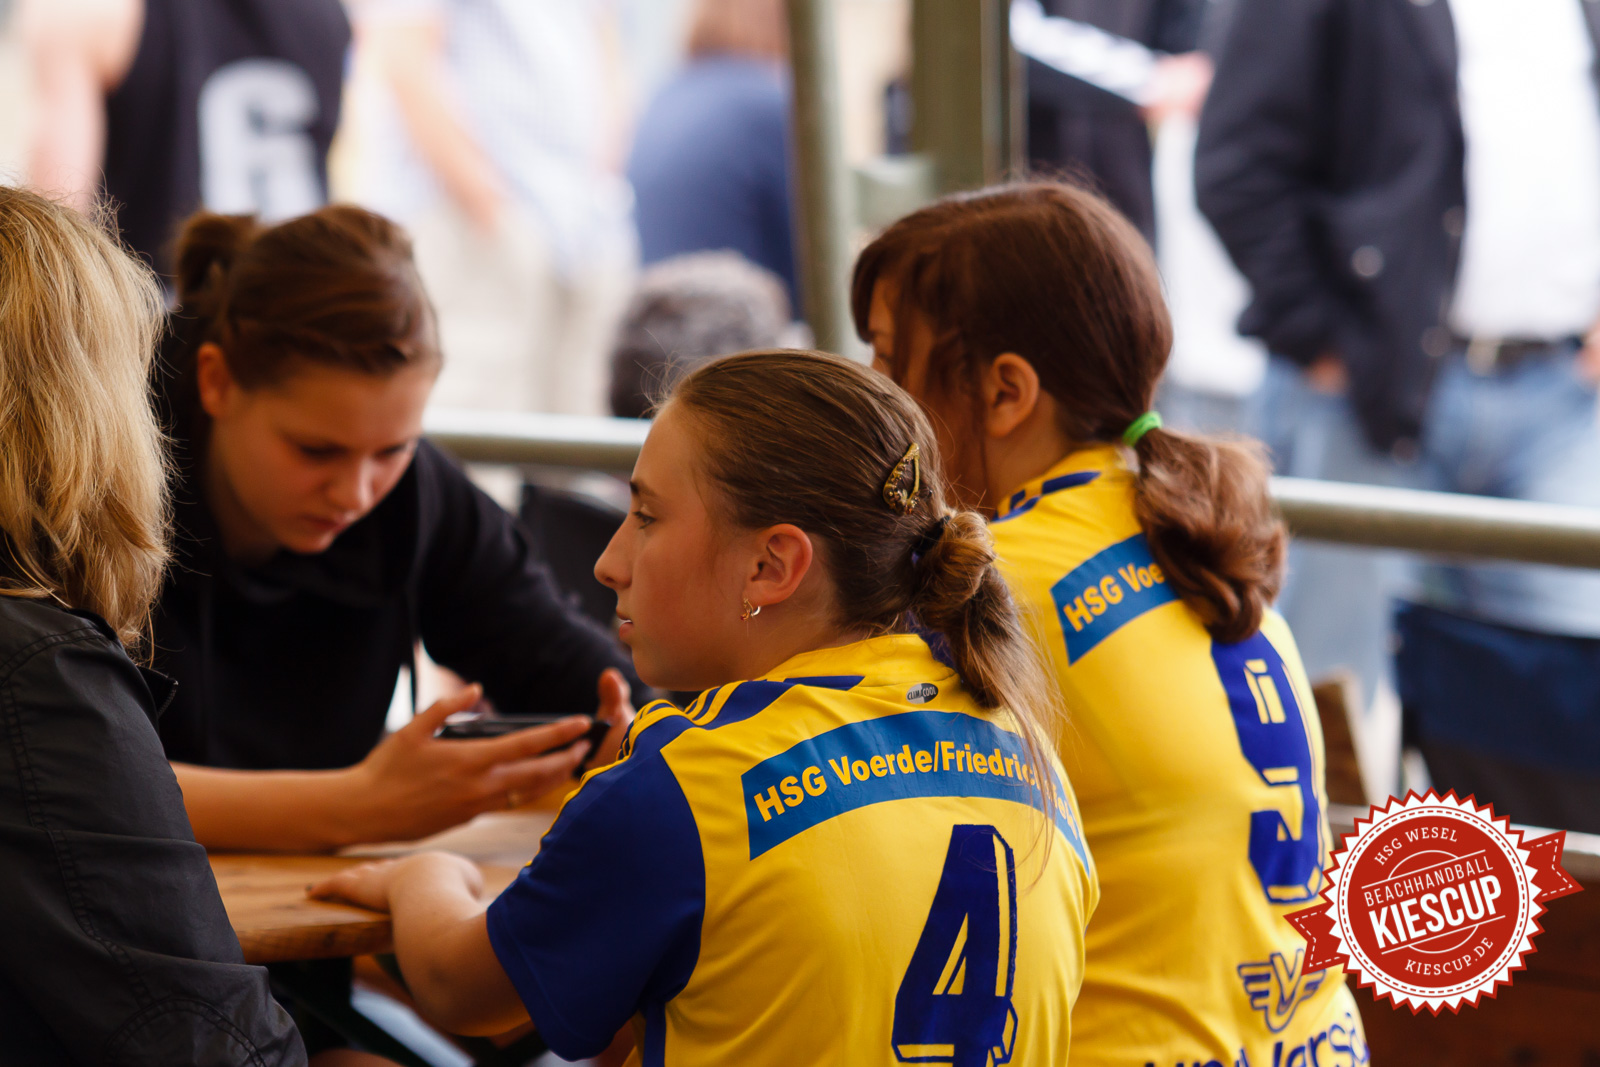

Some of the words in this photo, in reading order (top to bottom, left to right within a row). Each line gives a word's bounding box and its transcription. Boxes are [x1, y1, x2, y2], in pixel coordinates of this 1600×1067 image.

[1063, 574, 1124, 632] HSG
[1117, 563, 1165, 593] Voe
[753, 765, 828, 823] HSG
[891, 824, 1018, 1067] 4
